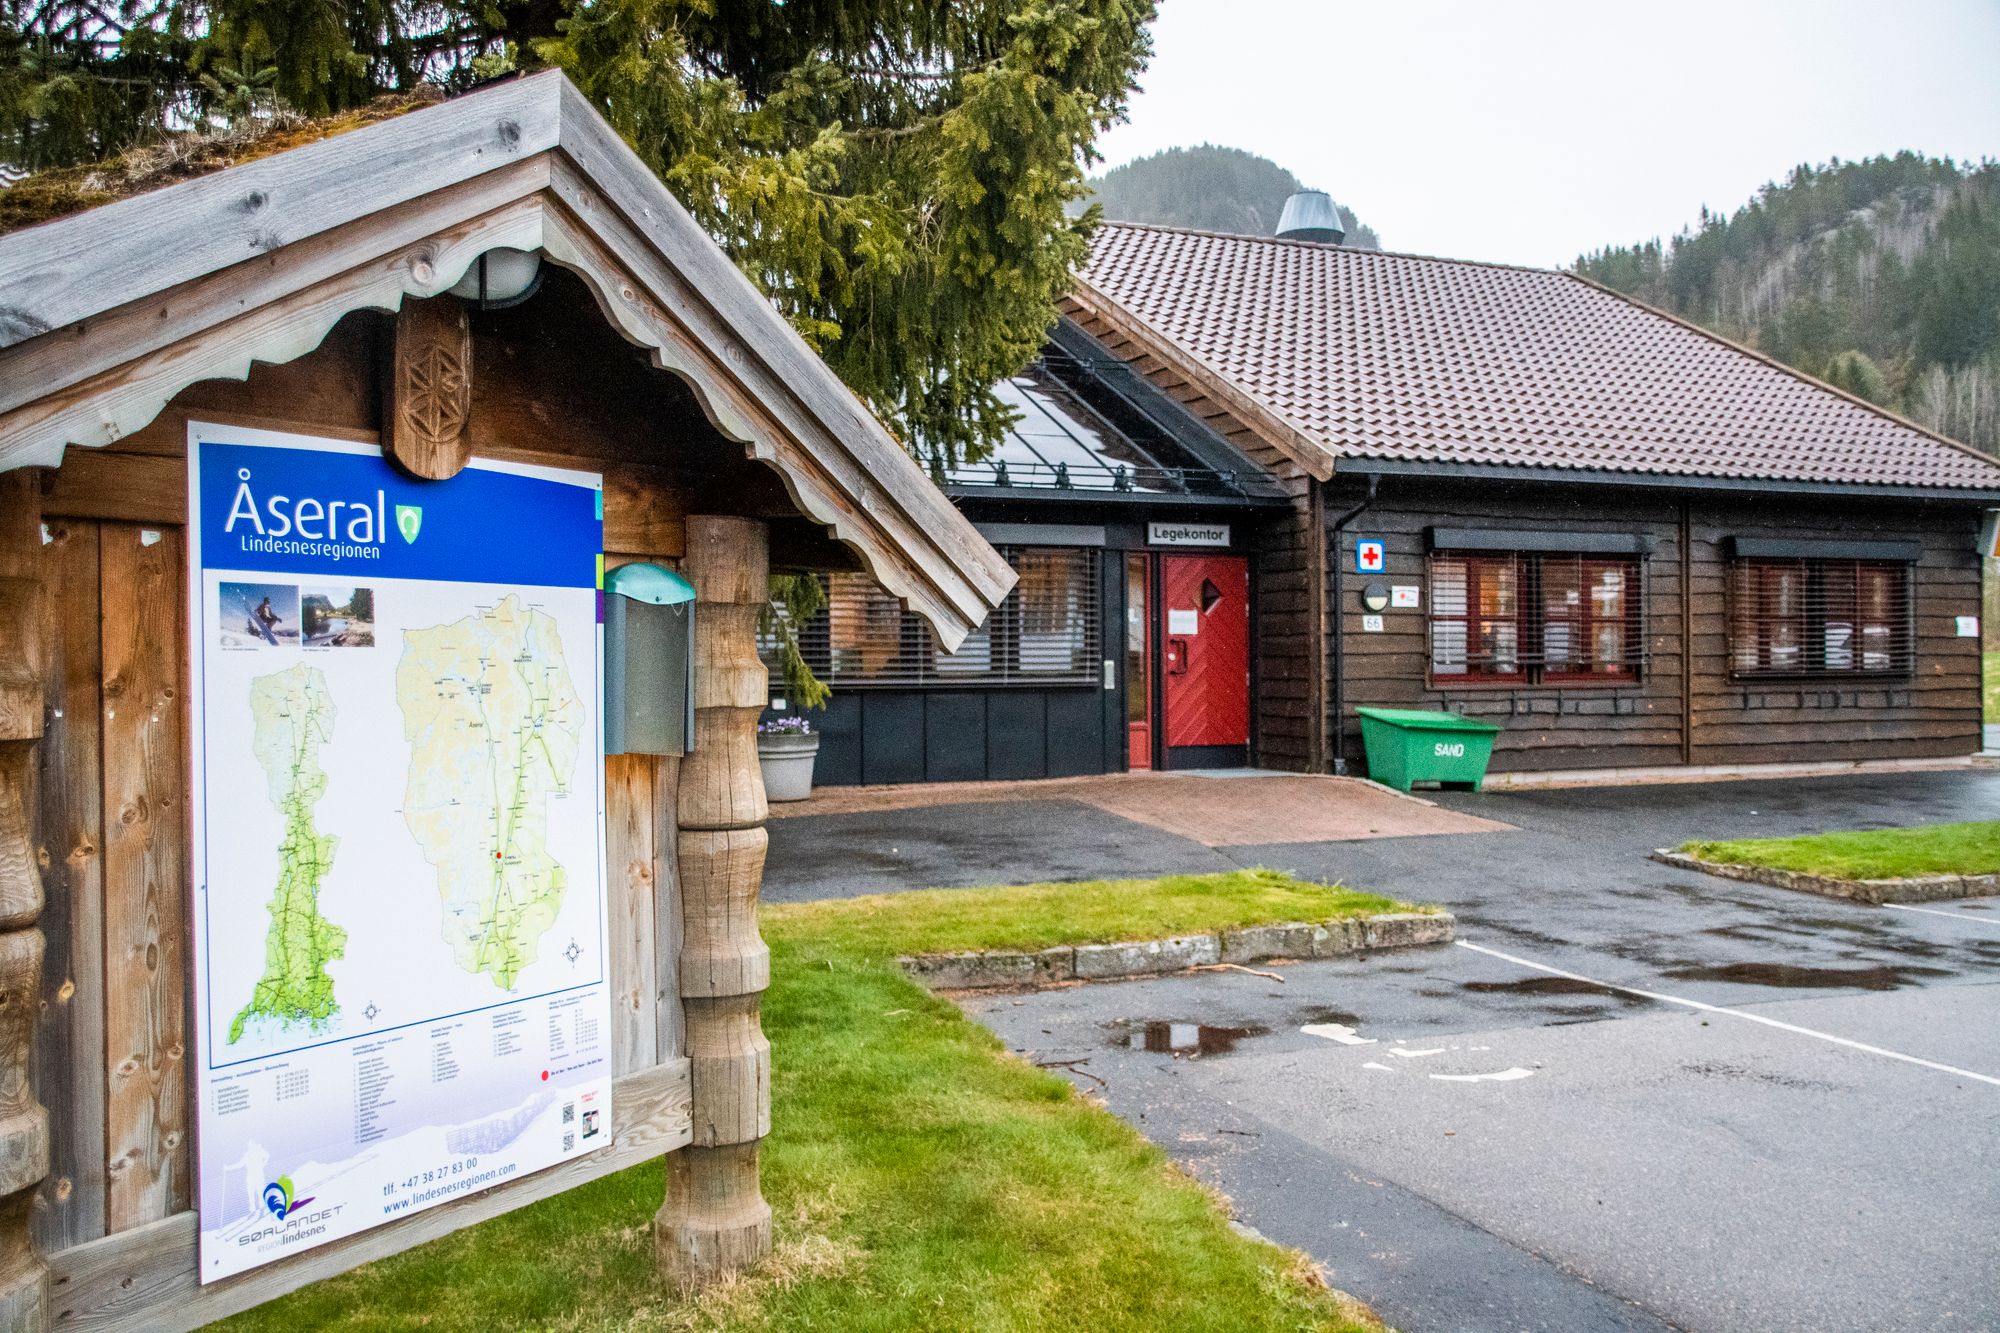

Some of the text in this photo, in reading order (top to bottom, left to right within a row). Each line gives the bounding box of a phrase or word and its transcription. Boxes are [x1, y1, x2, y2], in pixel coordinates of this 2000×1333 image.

[224, 467, 386, 544] Åseral
[240, 534, 380, 562] Lindesnesregionen
[1154, 527, 1224, 542] Legekontor
[1367, 617, 1380, 628] 66
[1435, 743, 1464, 757] SAND
[383, 1157, 478, 1196] tlf. +47 38 27 83 00
[383, 1162, 517, 1214] www.lindesnesregionen.com
[238, 1205, 343, 1247] SØRLANDET
